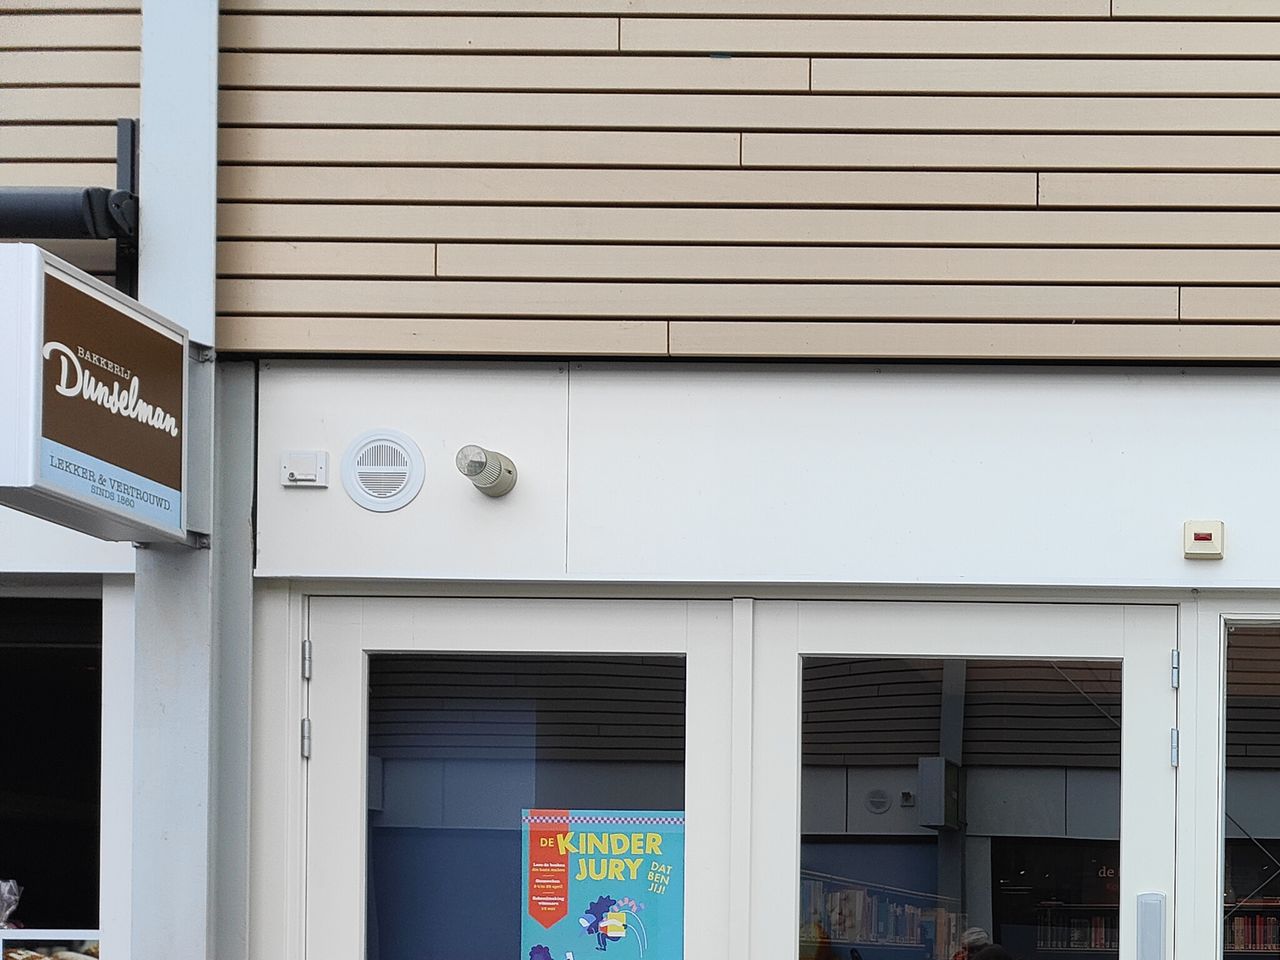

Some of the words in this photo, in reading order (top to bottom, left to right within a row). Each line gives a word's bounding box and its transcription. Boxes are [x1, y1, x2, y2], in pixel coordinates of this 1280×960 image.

[77, 346, 131, 380] BAKKERIJ
[43, 341, 178, 437] Dunselman
[49, 455, 96, 483] LEKKER
[98, 474, 107, 486] &
[91, 484, 115, 501] SINDS
[540, 838, 555, 847] DE
[556, 831, 662, 855] KINDER
[575, 858, 644, 881] JURY
[647, 871, 670, 886] BEN
[650, 861, 673, 875] DAT
